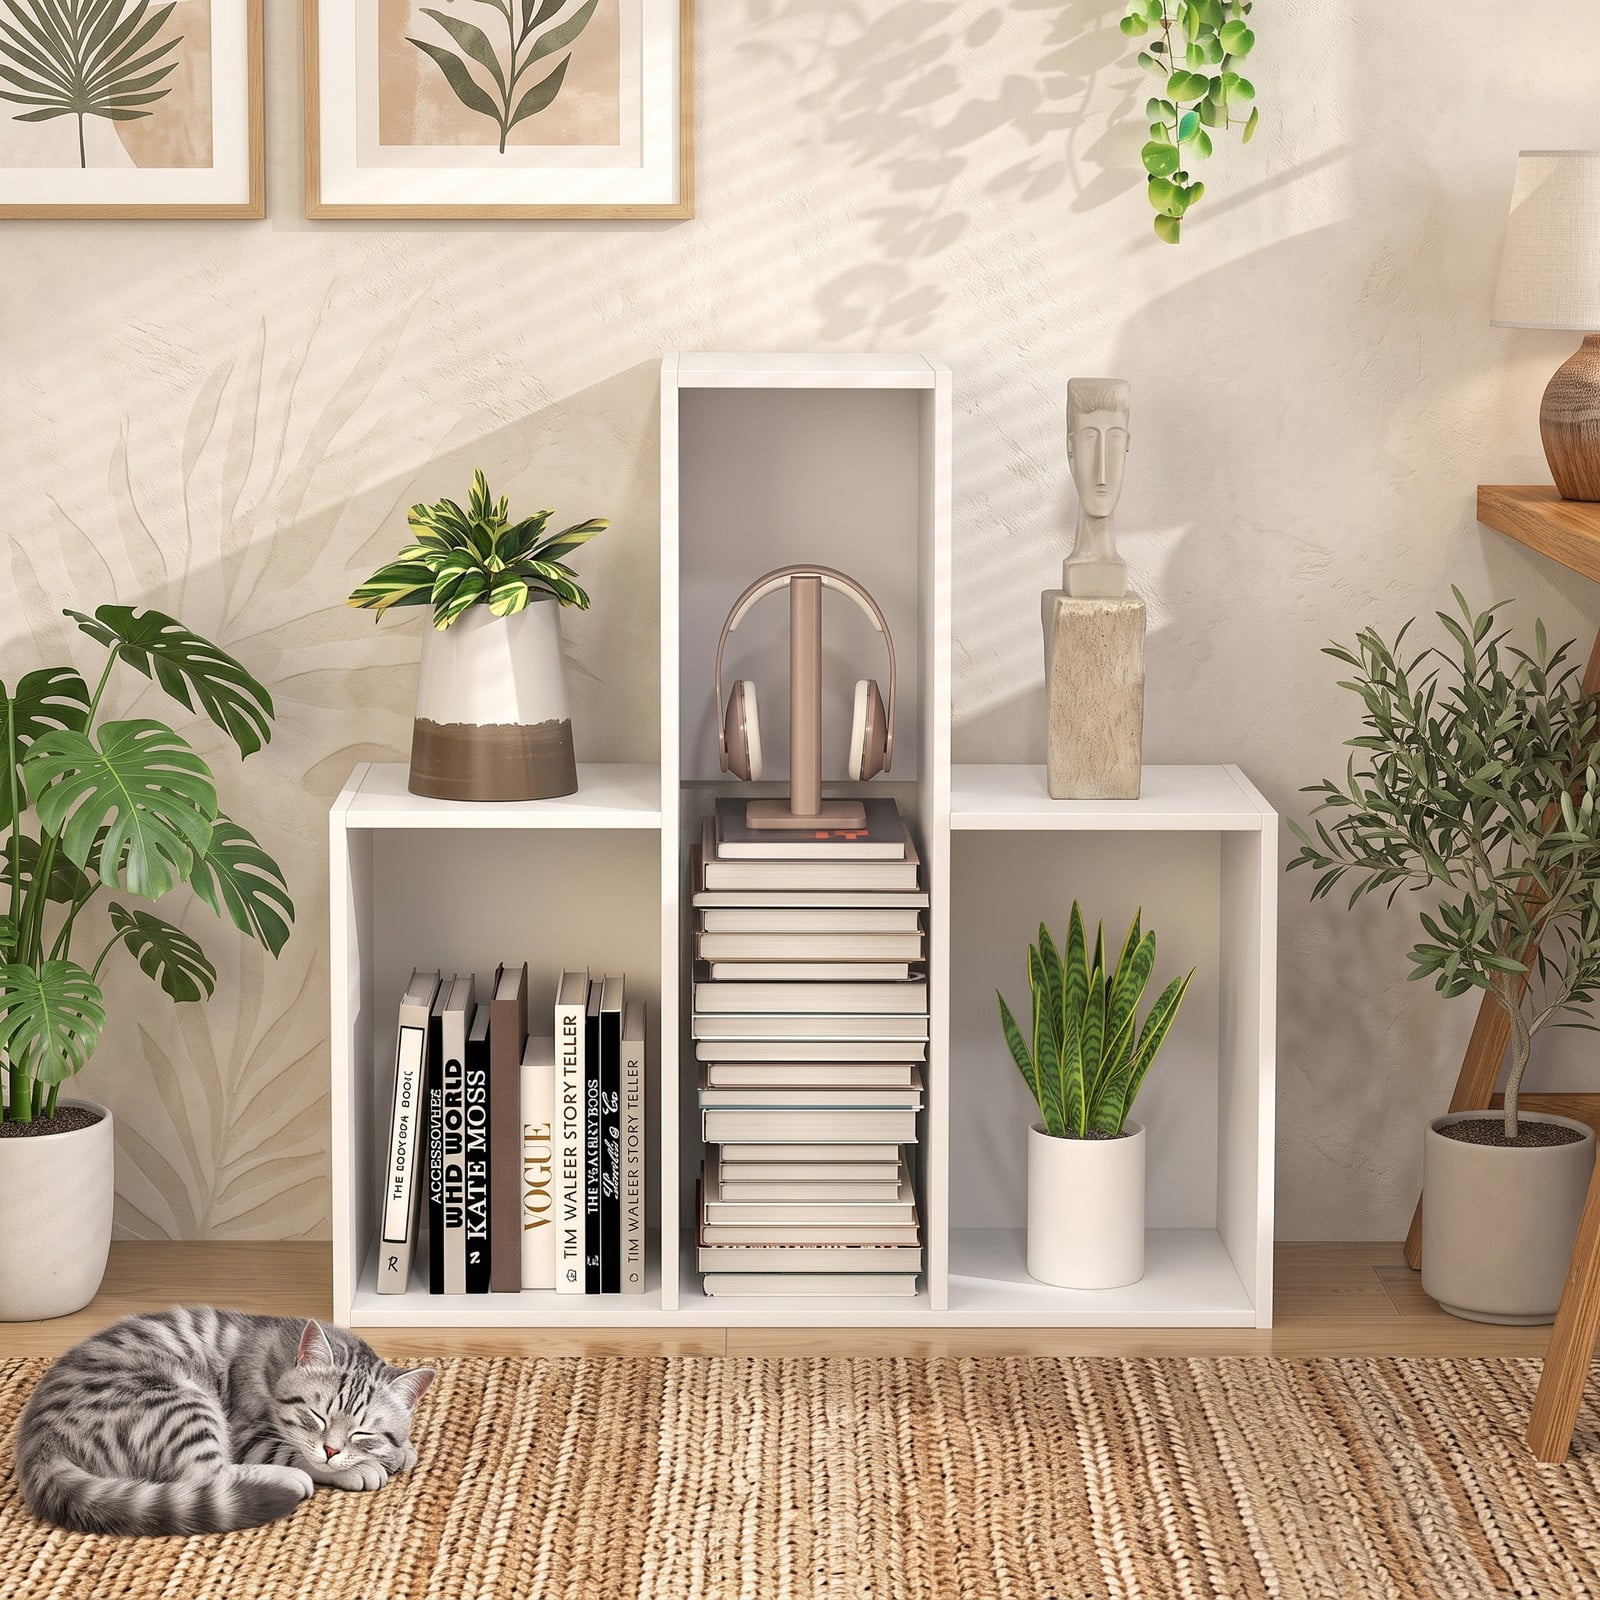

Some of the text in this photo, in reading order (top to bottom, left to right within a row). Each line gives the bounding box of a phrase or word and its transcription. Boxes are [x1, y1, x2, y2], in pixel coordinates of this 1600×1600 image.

[393, 1176, 403, 1200] THE
[445, 1058, 462, 1228] WHD WORLD
[467, 1070, 487, 1240] KATE MOSS
[523, 1123, 553, 1232] VOGUE
[563, 1015, 577, 1259] TIM WALEER STORY TELLER
[587, 1187, 599, 1215] THE
[627, 1060, 639, 1263] TIM WALEER STORY TELLER
